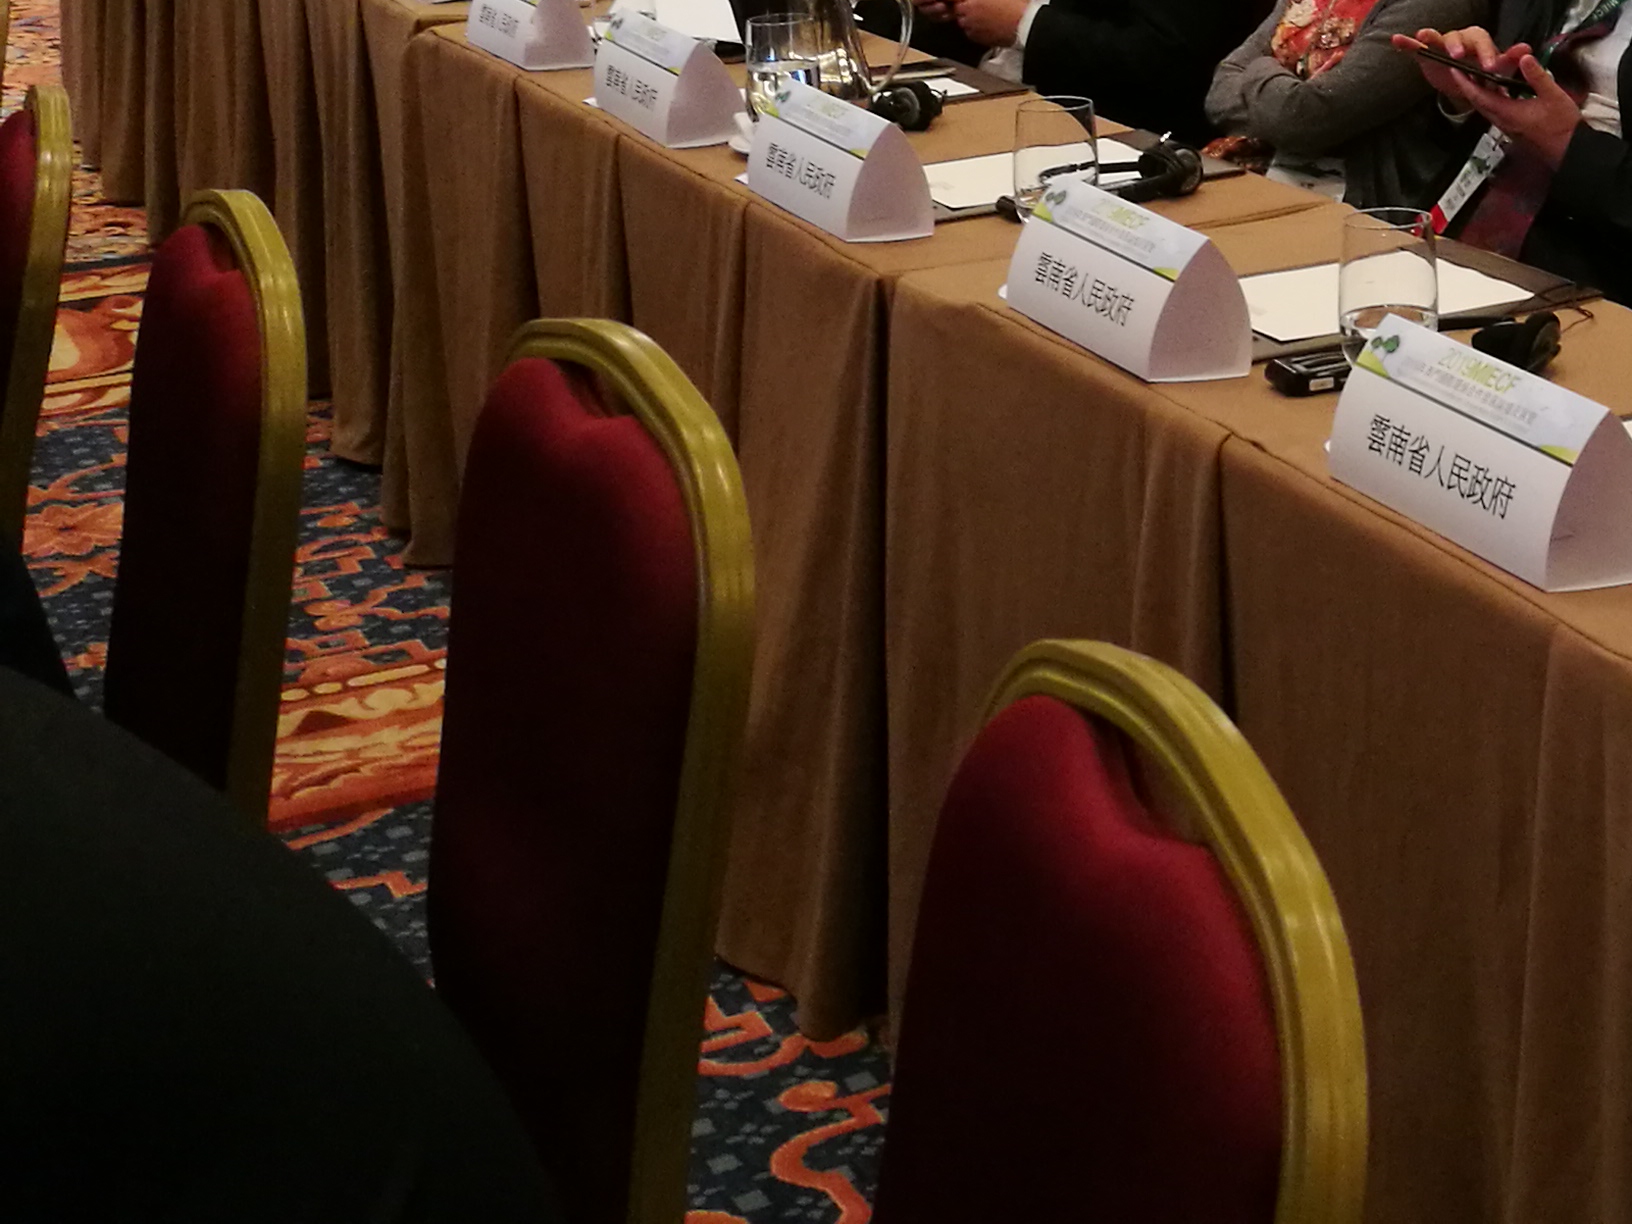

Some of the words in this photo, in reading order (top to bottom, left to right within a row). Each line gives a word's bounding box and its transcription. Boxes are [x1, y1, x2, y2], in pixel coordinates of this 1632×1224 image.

[1367, 413, 1516, 520] 雲南省人民政府
